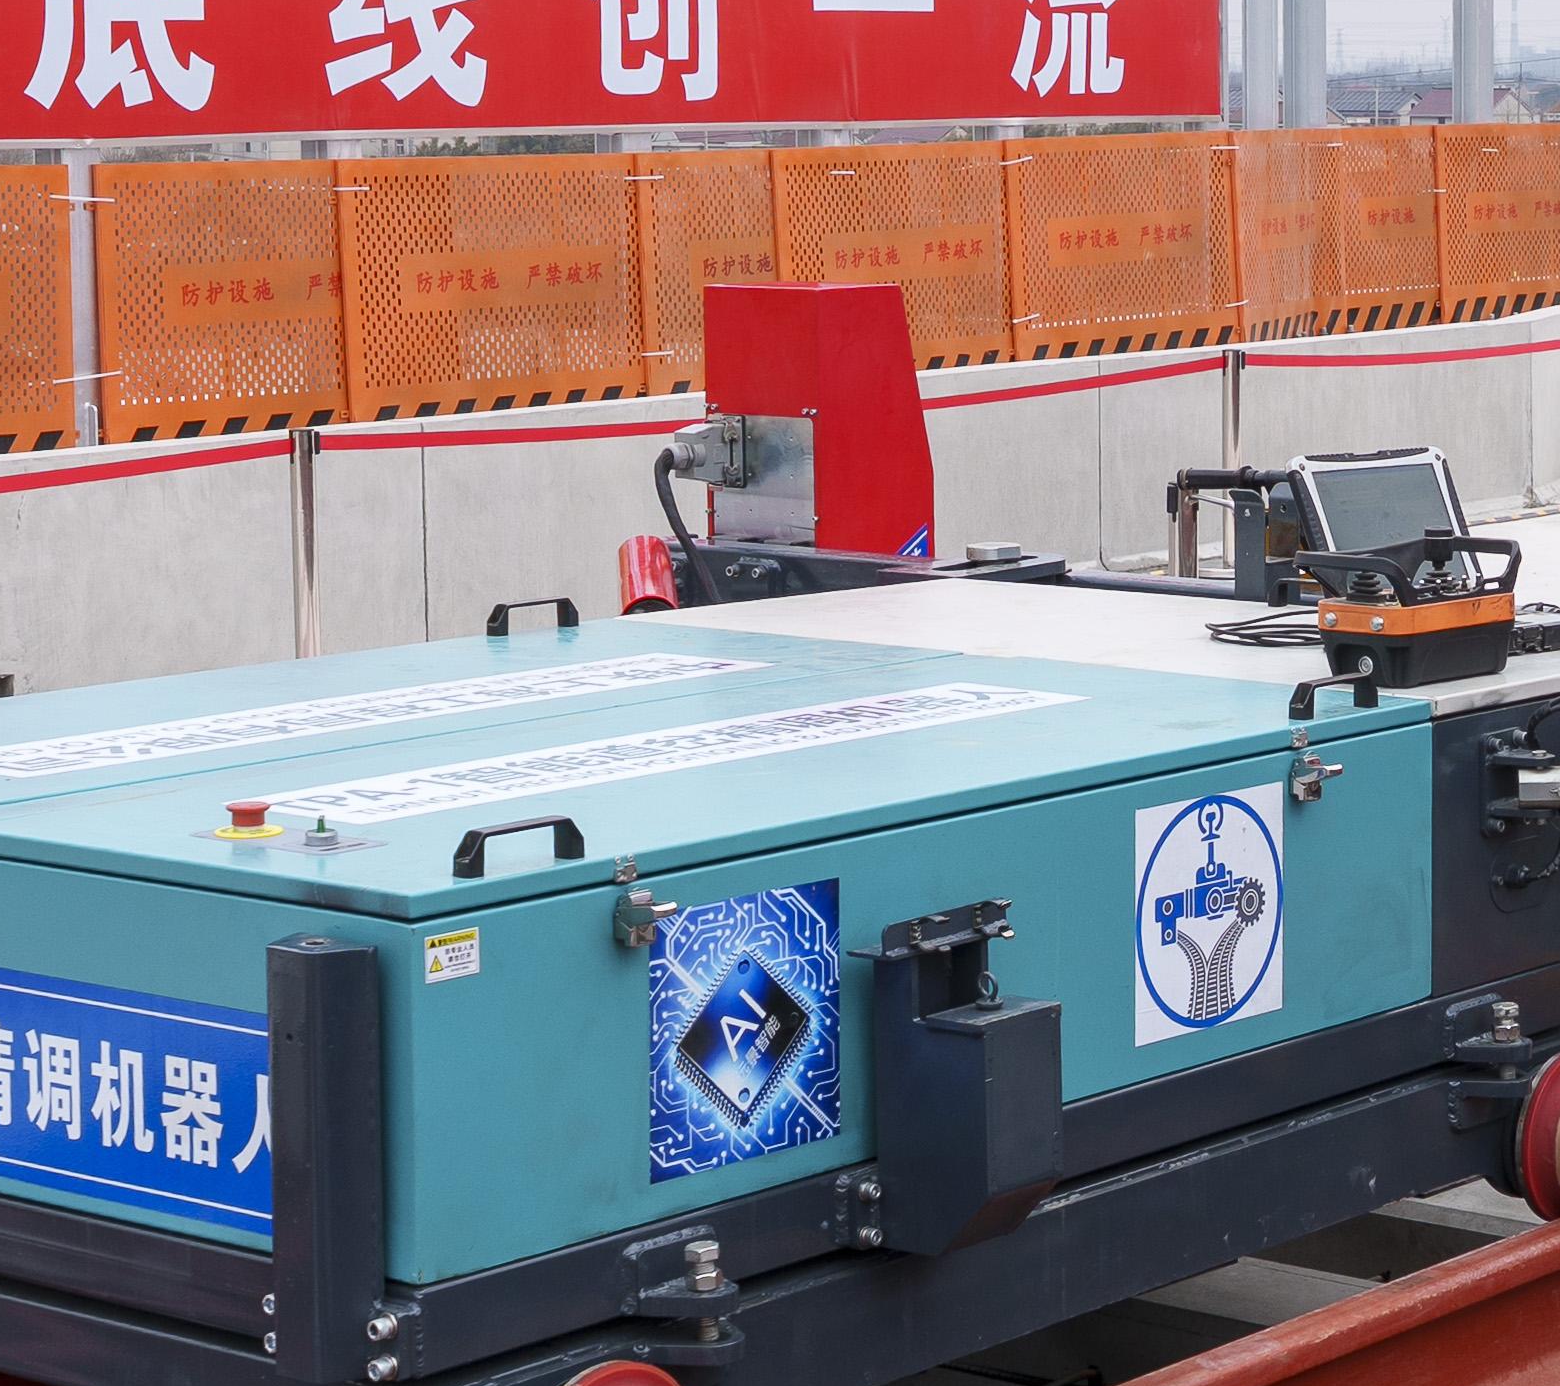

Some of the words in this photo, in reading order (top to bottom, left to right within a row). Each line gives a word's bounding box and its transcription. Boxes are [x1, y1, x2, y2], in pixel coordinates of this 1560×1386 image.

[1059, 227, 1119, 250] 防护设施
[1139, 222, 1192, 246] 严禁破坏
[702, 252, 774, 278] 防护设施
[835, 244, 900, 269] 防护设施
[924, 238, 983, 262] 严禁破坏
[181, 277, 274, 307] 防护设施
[417, 267, 500, 294] 防护设施
[528, 261, 602, 287] 严禁破坏
[343, 789, 500, 815] TURNOUT
[720, 987, 768, 1063] AI
